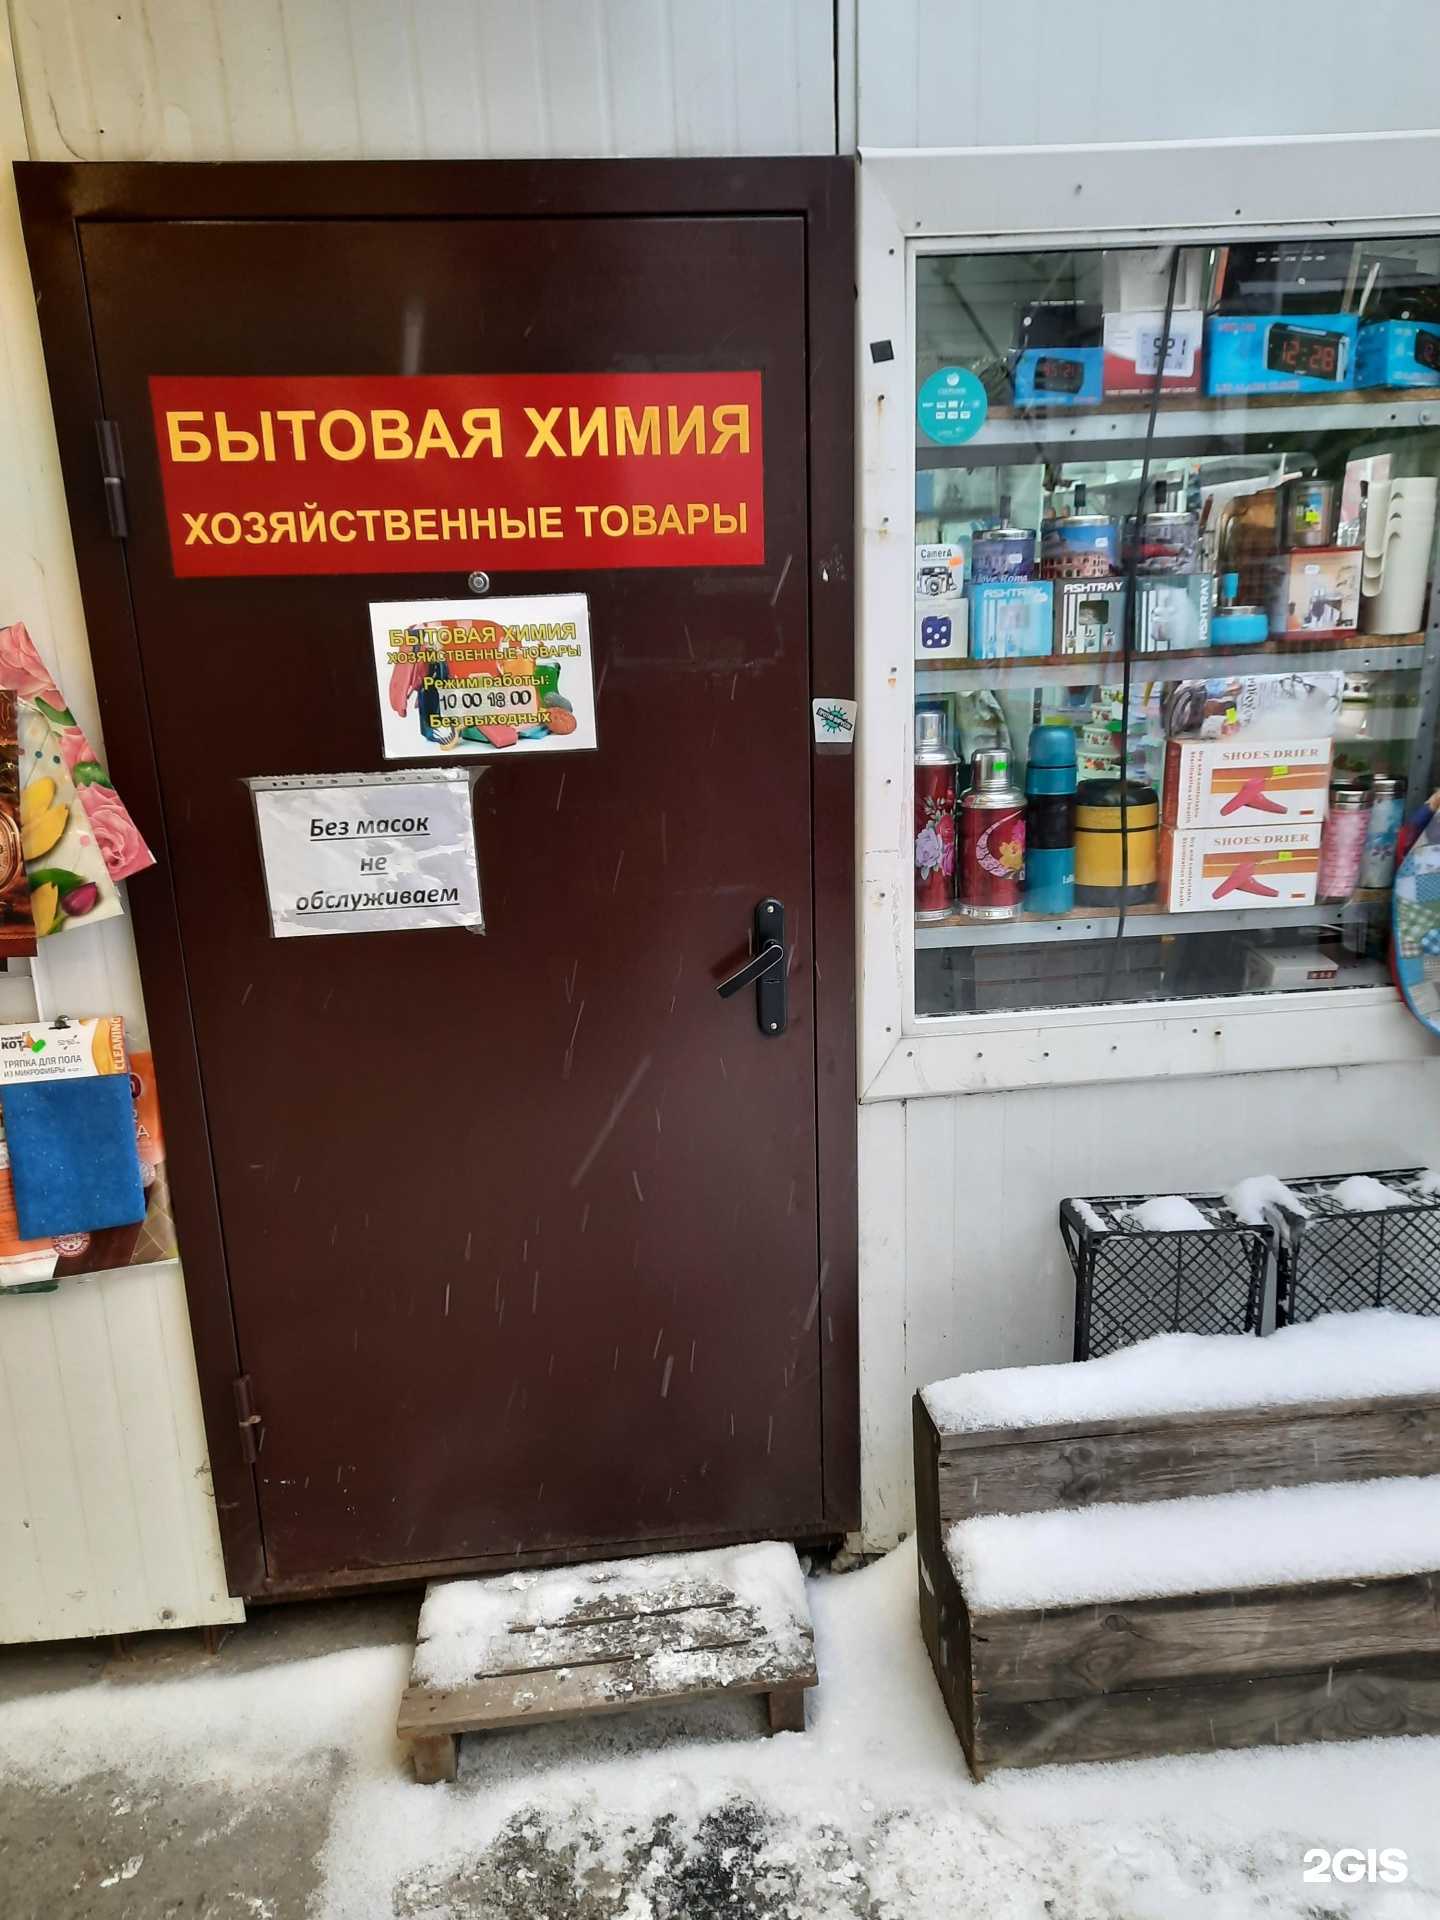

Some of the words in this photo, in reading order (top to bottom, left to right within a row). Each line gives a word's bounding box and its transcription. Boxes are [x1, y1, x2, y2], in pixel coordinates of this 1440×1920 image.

[166, 408, 503, 462] БЫТОВАЯ
[525, 404, 750, 457] ХИМИЯ
[182, 502, 563, 545] ХОЗЯЙСТВЕННЫЕ
[576, 502, 748, 537] ТОВАРЫ
[1063, 582, 1123, 593] ASHTRAY
[388, 626, 496, 647] БЫТОВАЯ
[503, 623, 577, 642] ХИМИЯ
[386, 648, 518, 664] ХОЗЯЙСТВЕННЫЕ
[522, 645, 582, 660] ТОВАРЫ
[423, 676, 479, 690] Режим
[483, 673, 551, 689] работы:
[462, 693, 482, 708] 00
[487, 692, 505, 707] 18
[511, 690, 531, 705] 00
[429, 713, 460, 728] Без
[464, 711, 552, 726] выходных
[1222, 750, 1270, 761] SHOES
[1273, 748, 1319, 759] DRIER
[310, 818, 349, 837] Без
[356, 816, 430, 834] масок
[1214, 836, 1260, 846] SHOES
[1264, 834, 1310, 844] DRIER
[360, 856, 387, 872] не
[296, 887, 459, 911] обслуживаем
[1, 1040, 24, 1050] КОТ
[111, 1016, 125, 1072] CLEANING
[3, 1058, 37, 1069] ТРЯПКА
[39, 1056, 56, 1067] ДЛЯ
[58, 1055, 82, 1065] ПОЛА
